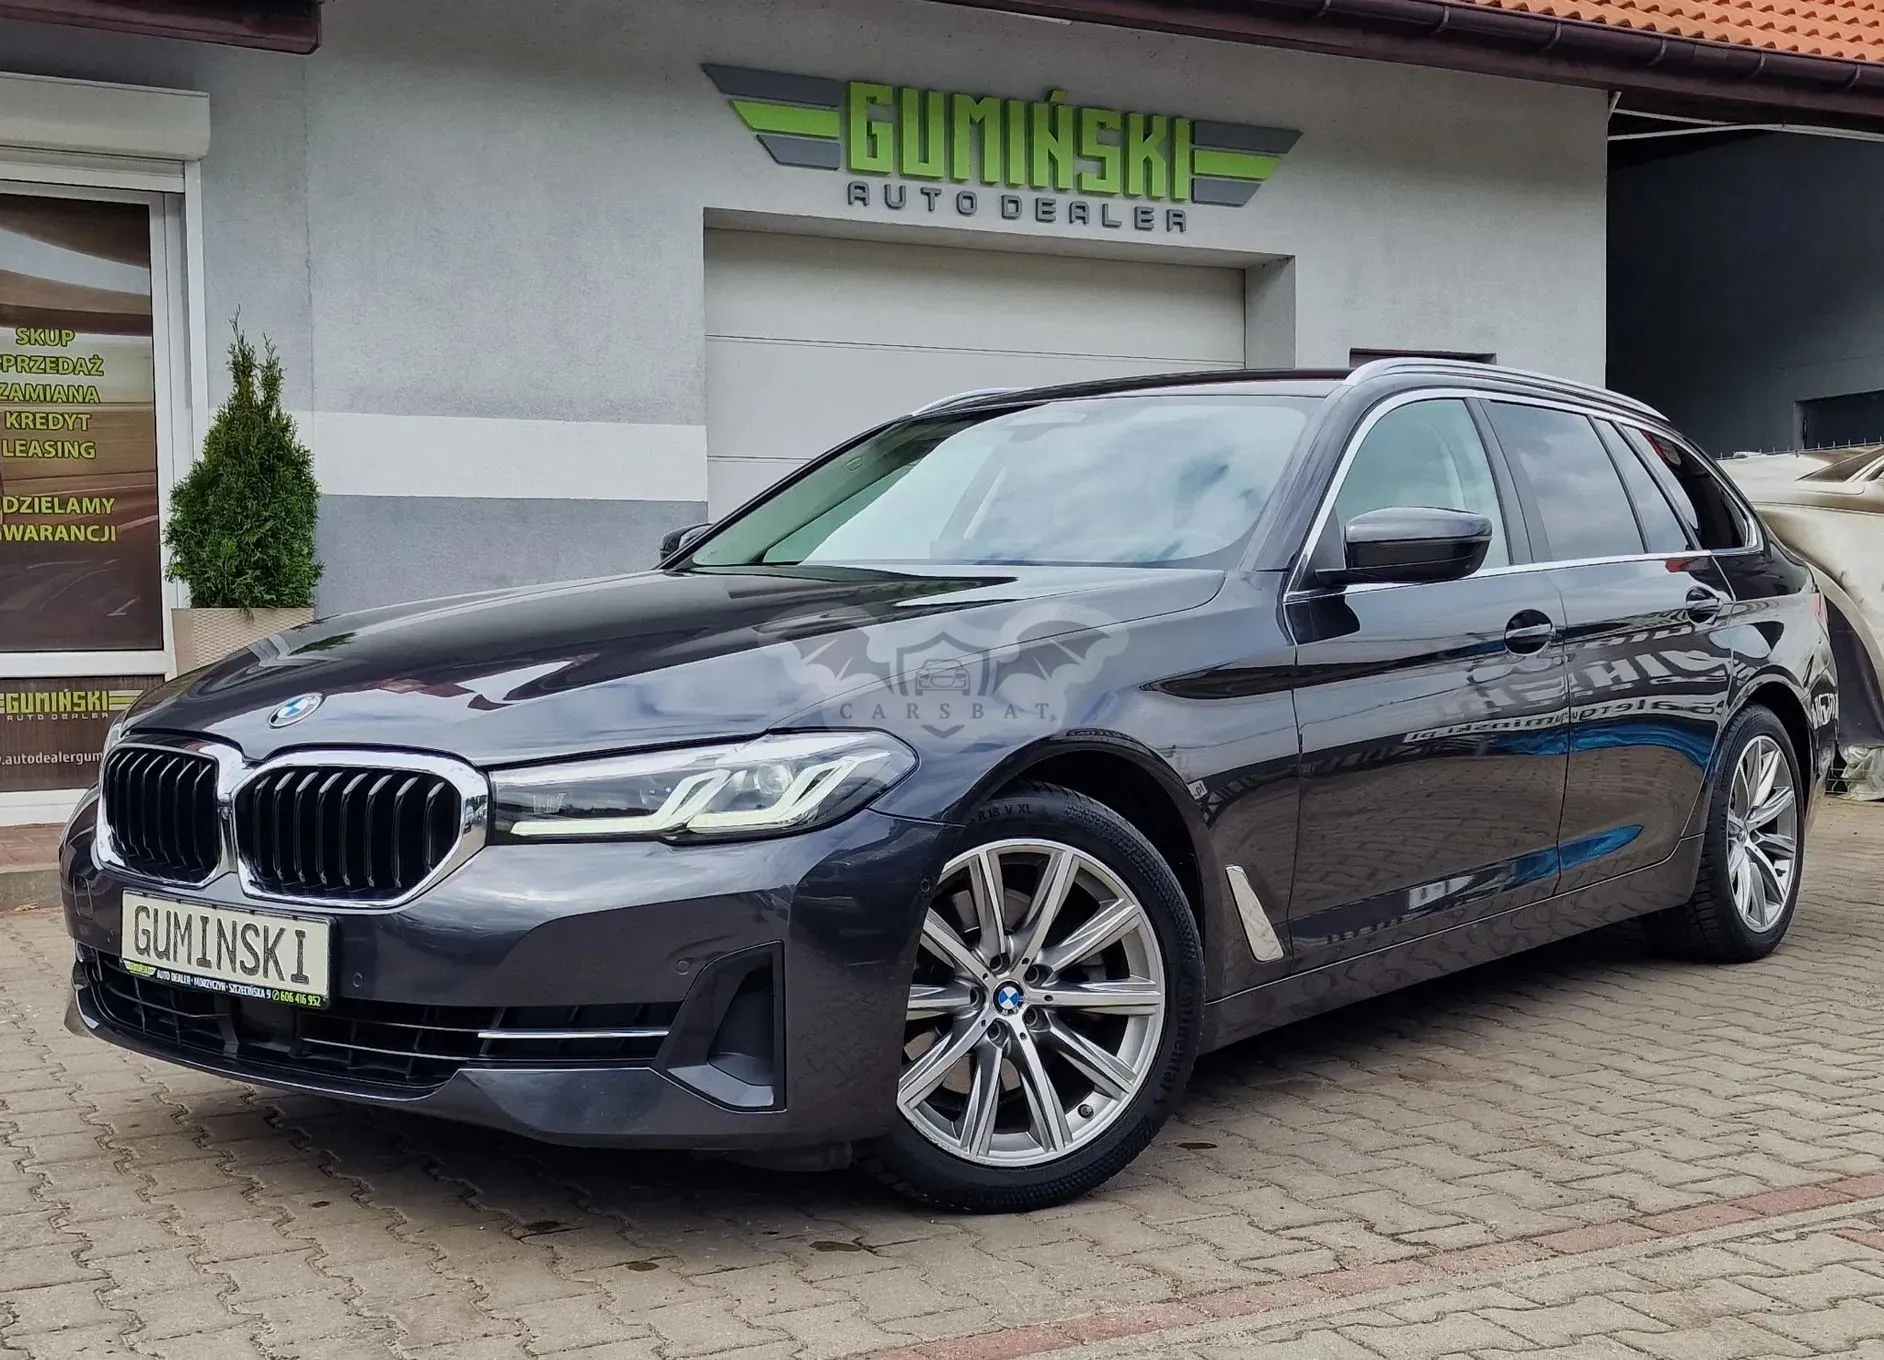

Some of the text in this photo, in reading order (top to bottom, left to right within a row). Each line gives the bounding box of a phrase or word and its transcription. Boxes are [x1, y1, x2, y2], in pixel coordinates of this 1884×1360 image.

[846, 81, 1192, 201] GUMIŃSKI
[847, 180, 1188, 233] AUTO DEALER
[16, 328, 75, 346] SKUP
[0, 354, 104, 376] PRZEDAŻ
[0, 382, 101, 403] ZAMIANA
[4, 412, 91, 431] KREDYT
[2, 439, 96, 459] LEASING
[0, 524, 118, 542] WARANCJI
[5, 688, 109, 714] GUMIŃSKI
[51, 712, 109, 721] DEALER
[0, 751, 103, 765] .autodealergum
[134, 905, 310, 985] GUMINSKI
[156, 970, 171, 981] AUTO
[171, 972, 191, 985] DEALER
[307, 996, 321, 1007] 952
